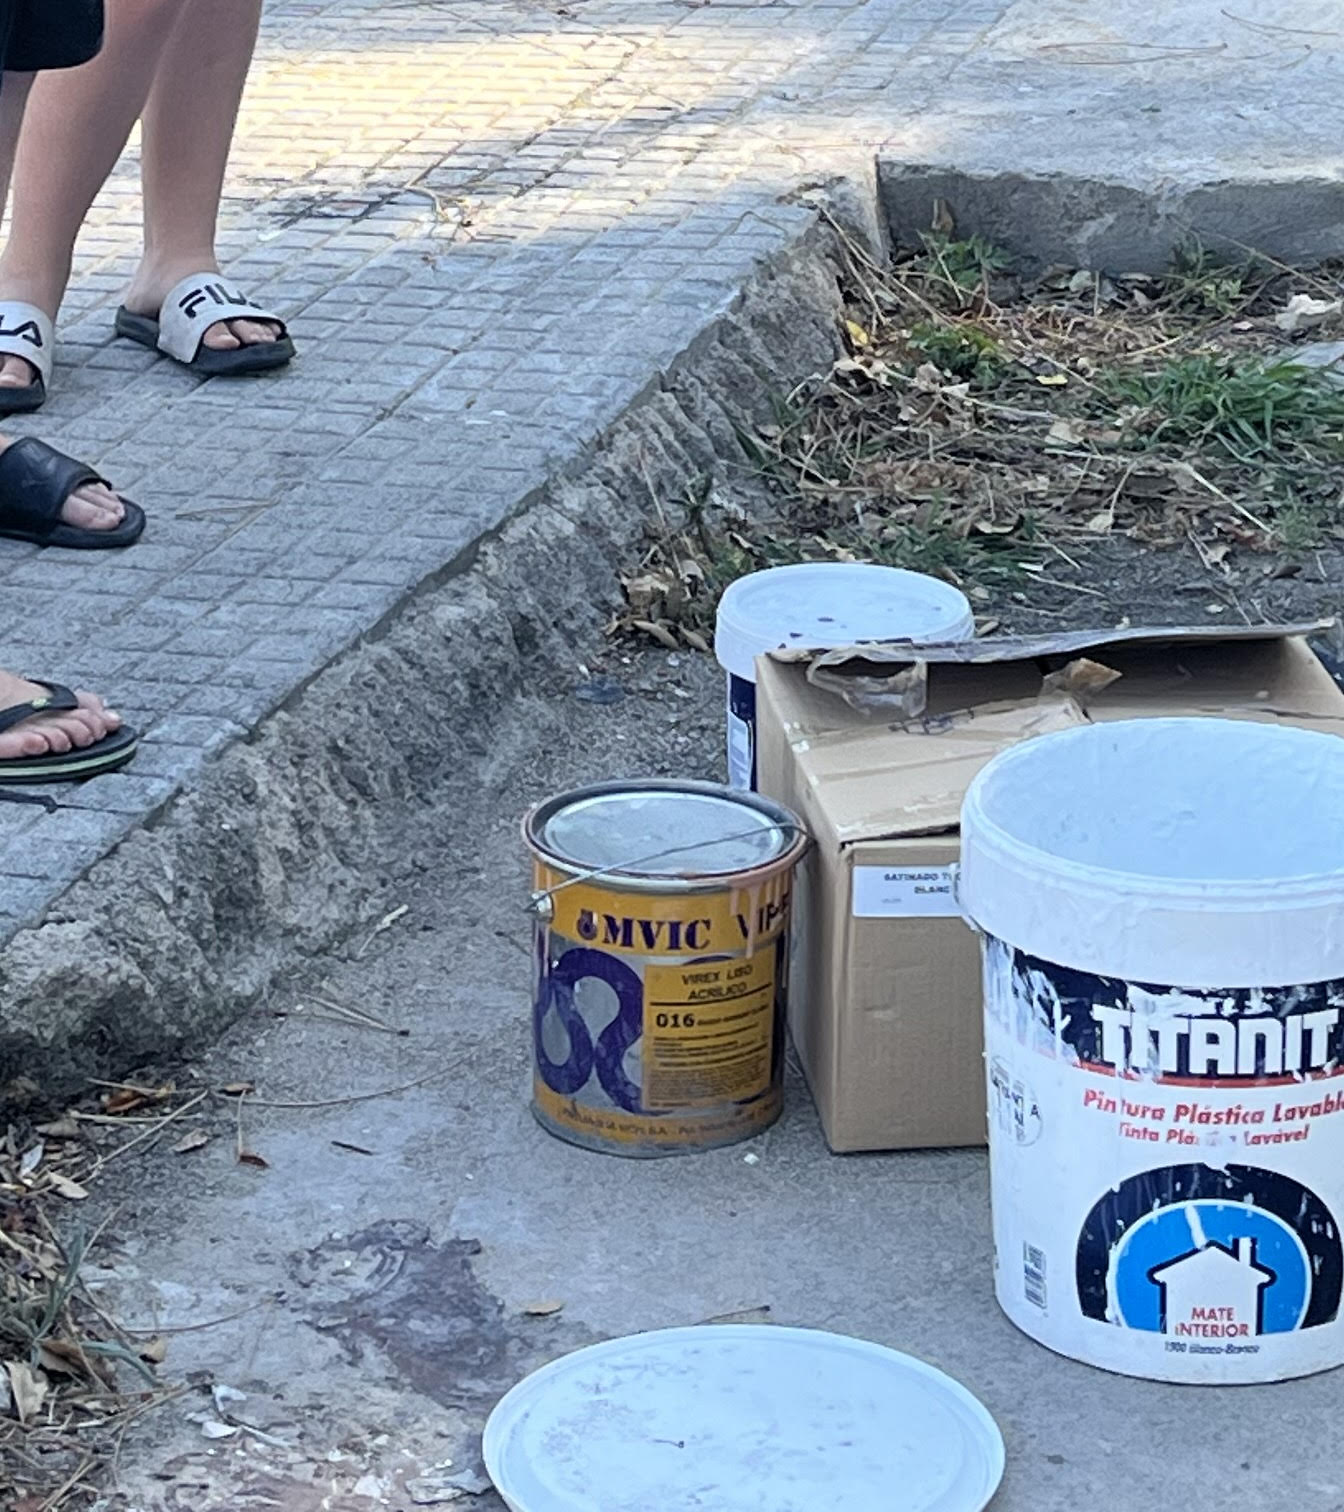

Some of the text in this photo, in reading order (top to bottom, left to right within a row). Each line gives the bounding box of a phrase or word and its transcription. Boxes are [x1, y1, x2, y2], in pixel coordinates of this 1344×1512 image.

[655, 1013, 695, 1029] 016
[1091, 1003, 1340, 1076] TITANIT
[1173, 1103, 1265, 1126] Plástica
[1191, 1307, 1235, 1322] MATE
[1174, 1322, 1250, 1338] INTERIOR
